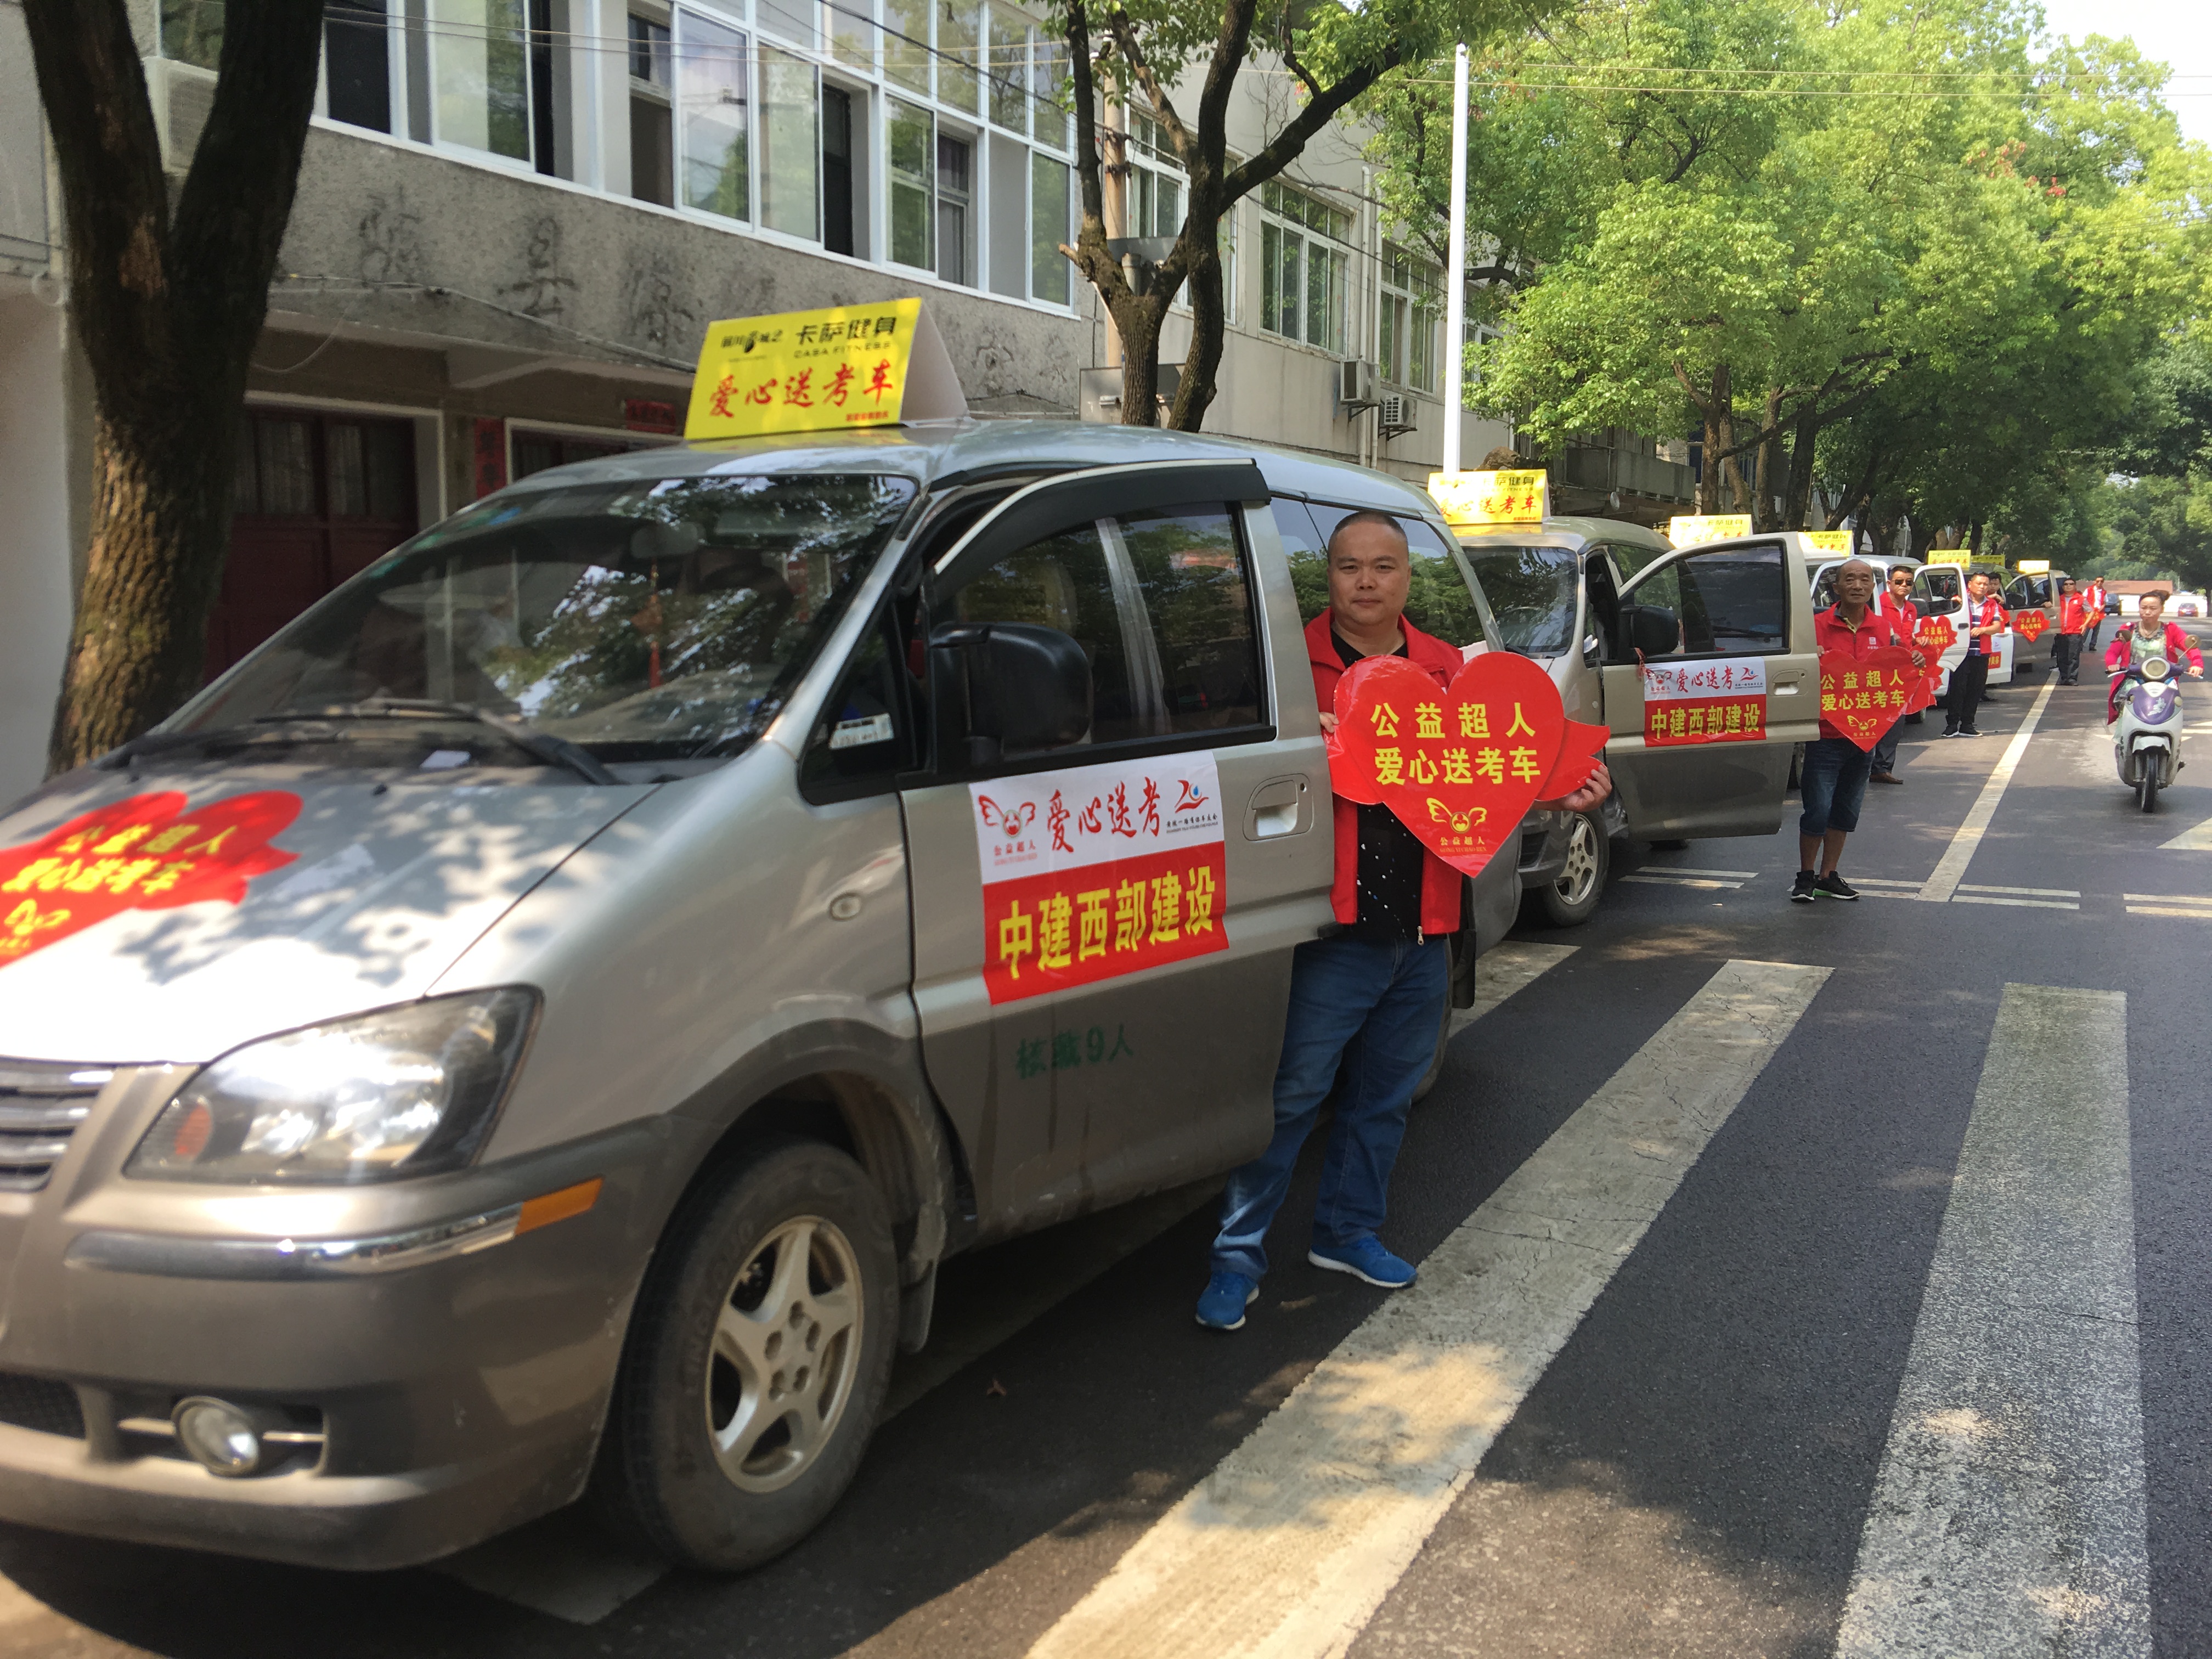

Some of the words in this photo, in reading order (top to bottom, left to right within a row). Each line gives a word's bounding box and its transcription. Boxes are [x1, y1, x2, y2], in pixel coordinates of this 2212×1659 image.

[709, 358, 893, 419] 爱心送考车
[1929, 635, 1948, 645] 心送考车
[1676, 665, 1734, 693] 爱心送考
[1820, 669, 1904, 690] 公益超人
[1821, 690, 1906, 712] 爱心送考车
[1370, 702, 1536, 739] 公益超人
[1651, 704, 1760, 739] 中建西部建设
[1374, 746, 1541, 786] 爱心送考车
[1047, 776, 1161, 853] 爱心送考
[994, 839, 1036, 857] 公益超人
[1440, 836, 1485, 846] 公益超人
[998, 865, 1216, 980] 中建西部建设
